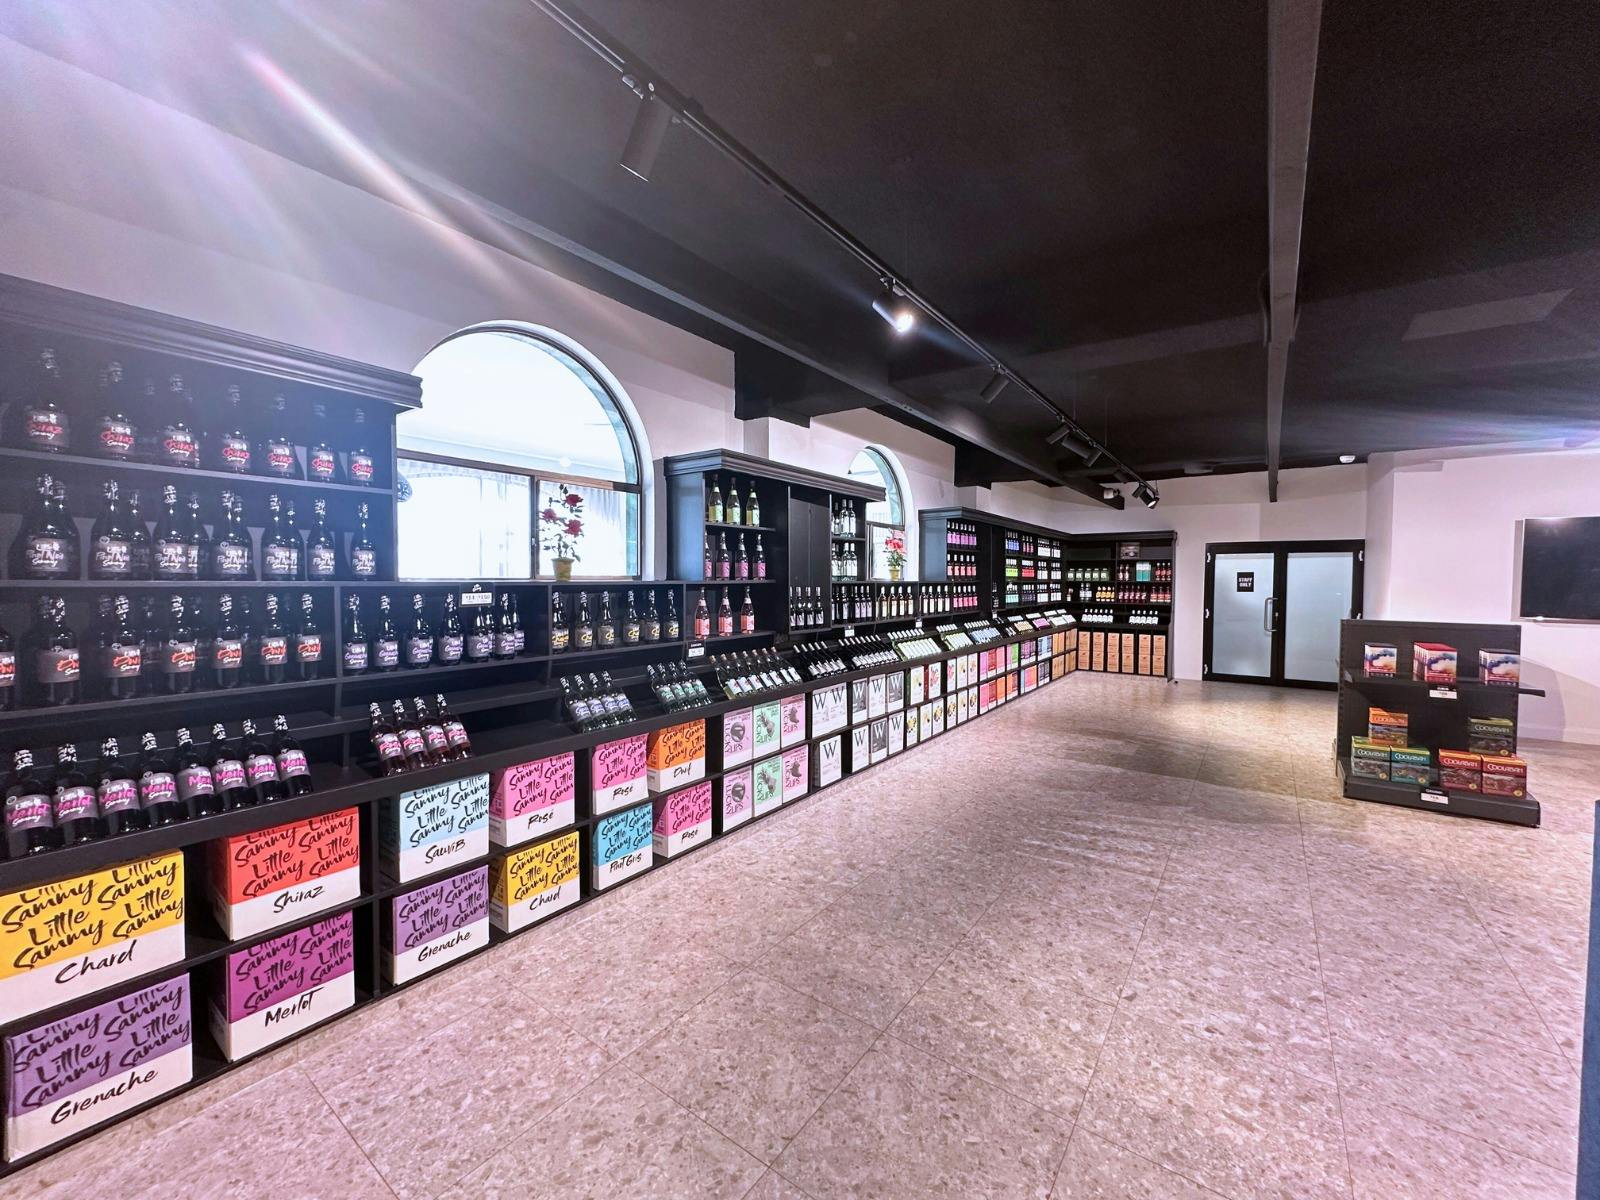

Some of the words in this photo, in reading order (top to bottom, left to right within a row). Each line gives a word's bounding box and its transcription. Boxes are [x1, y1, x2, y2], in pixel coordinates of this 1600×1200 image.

[813, 692, 826, 710] W
[831, 687, 844, 704] W
[853, 682, 865, 697] W
[872, 679, 883, 693] W
[854, 729, 866, 747] W
[874, 722, 885, 739] W
[892, 716, 902, 731] W
[823, 740, 838, 759] W
[509, 763, 544, 791] Sammy
[519, 779, 541, 799] Little
[404, 787, 450, 818] Sammy
[417, 806, 447, 829] Little
[465, 797, 488, 817] Little
[513, 788, 547, 817] Sammy
[298, 816, 354, 853] Sammy
[409, 815, 455, 848] Sammy
[458, 809, 488, 833] Samm
[235, 827, 299, 867] Sammy
[309, 845, 359, 877] Sammy
[318, 836, 352, 860] Little
[545, 839, 577, 867] Sammy
[243, 860, 305, 897] Sammy
[253, 850, 294, 879] Little
[510, 848, 545, 879] Sammy
[520, 865, 542, 887] Little
[97, 862, 179, 910] Sammy
[273, 886, 324, 913] Shiraz
[445, 874, 485, 908] Sammy
[529, 886, 561, 910] Chard
[1, 879, 98, 933] Sammy
[112, 897, 183, 939] Sammy
[125, 887, 174, 918] Little
[399, 886, 444, 923] Sammy
[458, 891, 482, 914] Little
[28, 909, 91, 945] Little
[404, 914, 448, 949] Sammy
[412, 907, 440, 932] Little
[13, 919, 108, 969] Sammy
[236, 935, 299, 981] Sammy
[319, 938, 352, 965] Little
[418, 931, 471, 962] Grenache
[55, 939, 137, 983] Chard
[254, 960, 294, 990] Little
[310, 953, 352, 986] Samm
[244, 967, 306, 1015] Sammy
[103, 985, 185, 1042] Sammy
[265, 987, 324, 1027] Merlot
[14, 1013, 103, 1073] Sammy
[119, 1020, 190, 1067] Sammy
[130, 1012, 179, 1047] Little
[36, 1043, 96, 1083] Little
[21, 1050, 113, 1108] Sammy
[51, 1070, 158, 1124] Grenache
